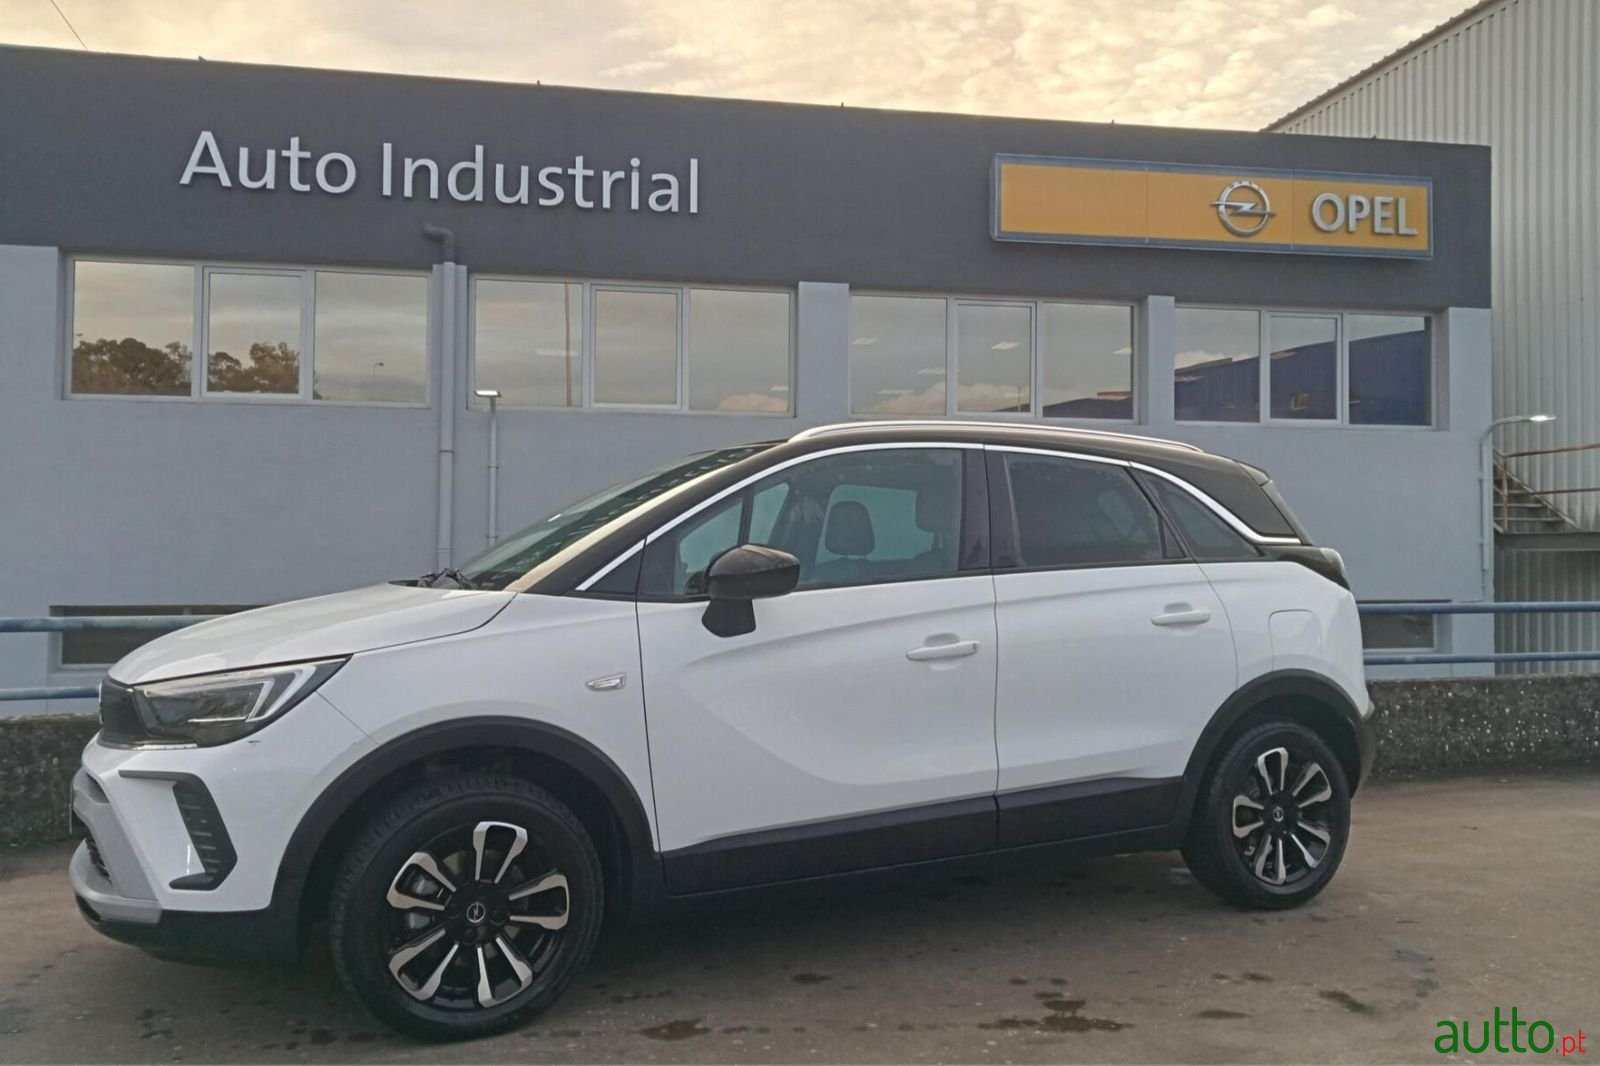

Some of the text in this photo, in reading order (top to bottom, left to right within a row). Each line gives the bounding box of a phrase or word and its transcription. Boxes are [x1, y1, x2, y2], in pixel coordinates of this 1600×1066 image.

[180, 130, 699, 214] Auto Industrial
[1312, 192, 1418, 236] OPEL
